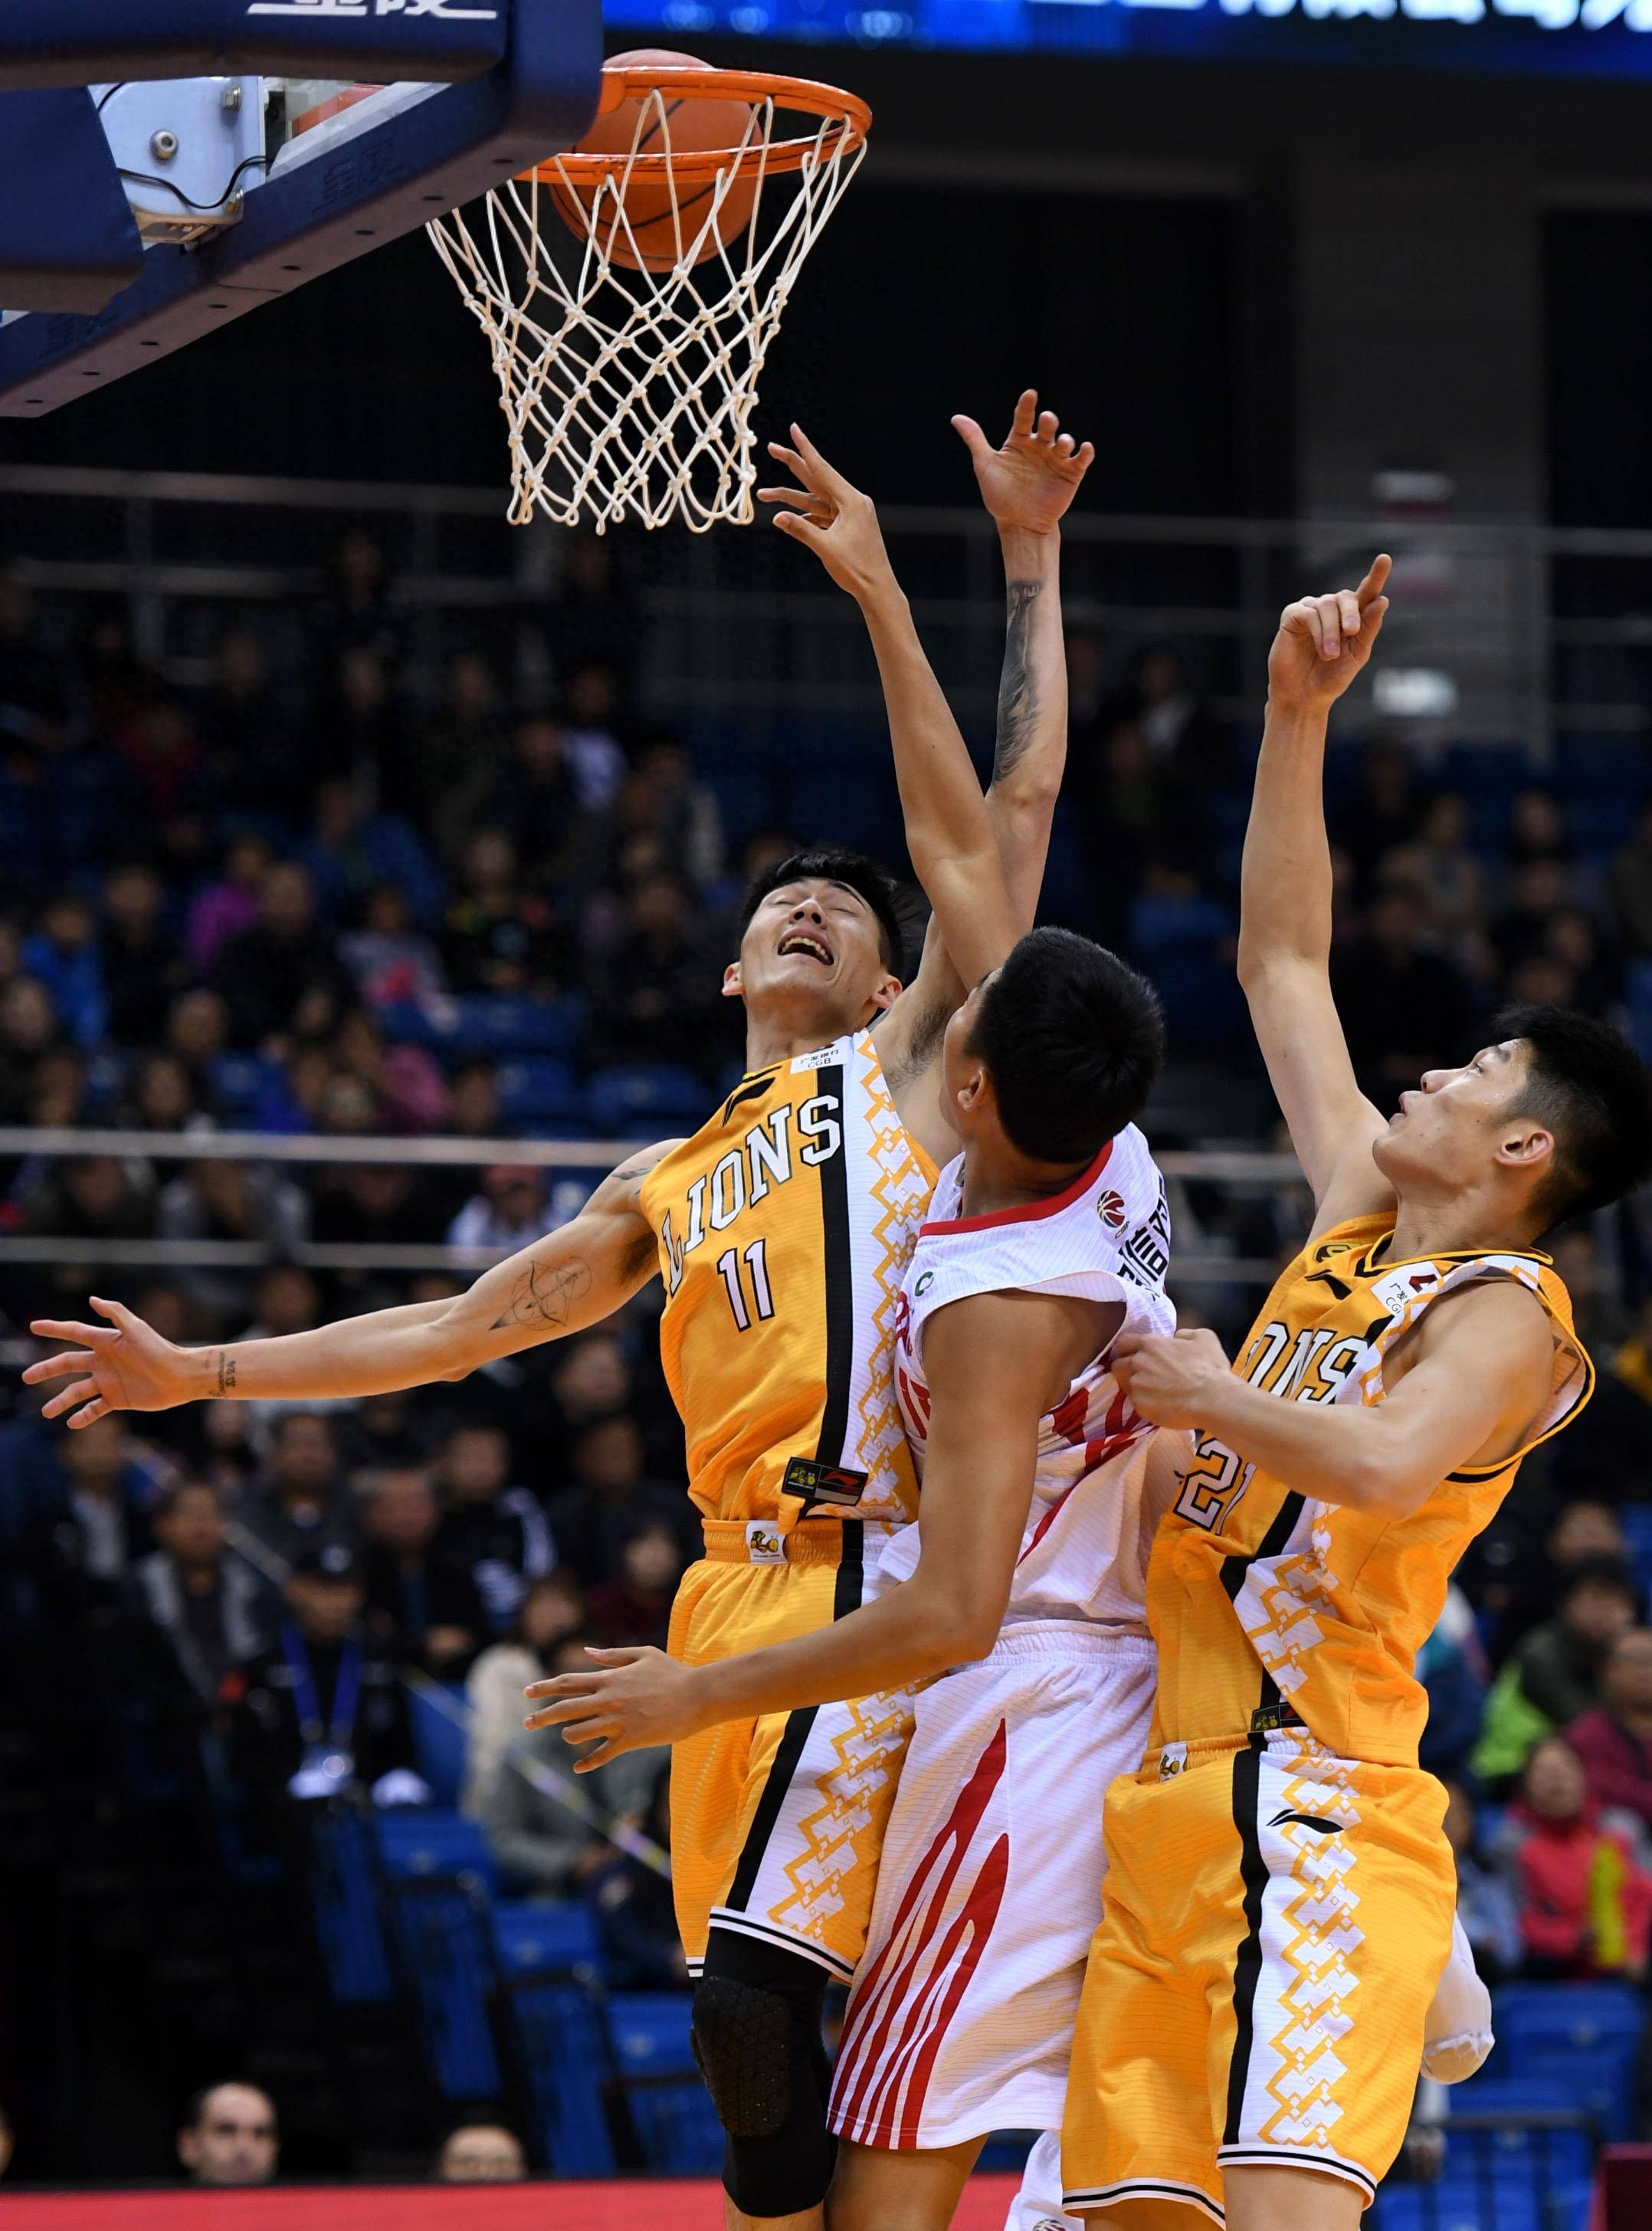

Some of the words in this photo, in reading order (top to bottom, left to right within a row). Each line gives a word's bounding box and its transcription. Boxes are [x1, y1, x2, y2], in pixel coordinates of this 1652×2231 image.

[808, 1058, 831, 1068] CGB
[662, 1094, 841, 1298] LIONS
[716, 1238, 775, 1333] 11
[1385, 1297, 1401, 1314] CG
